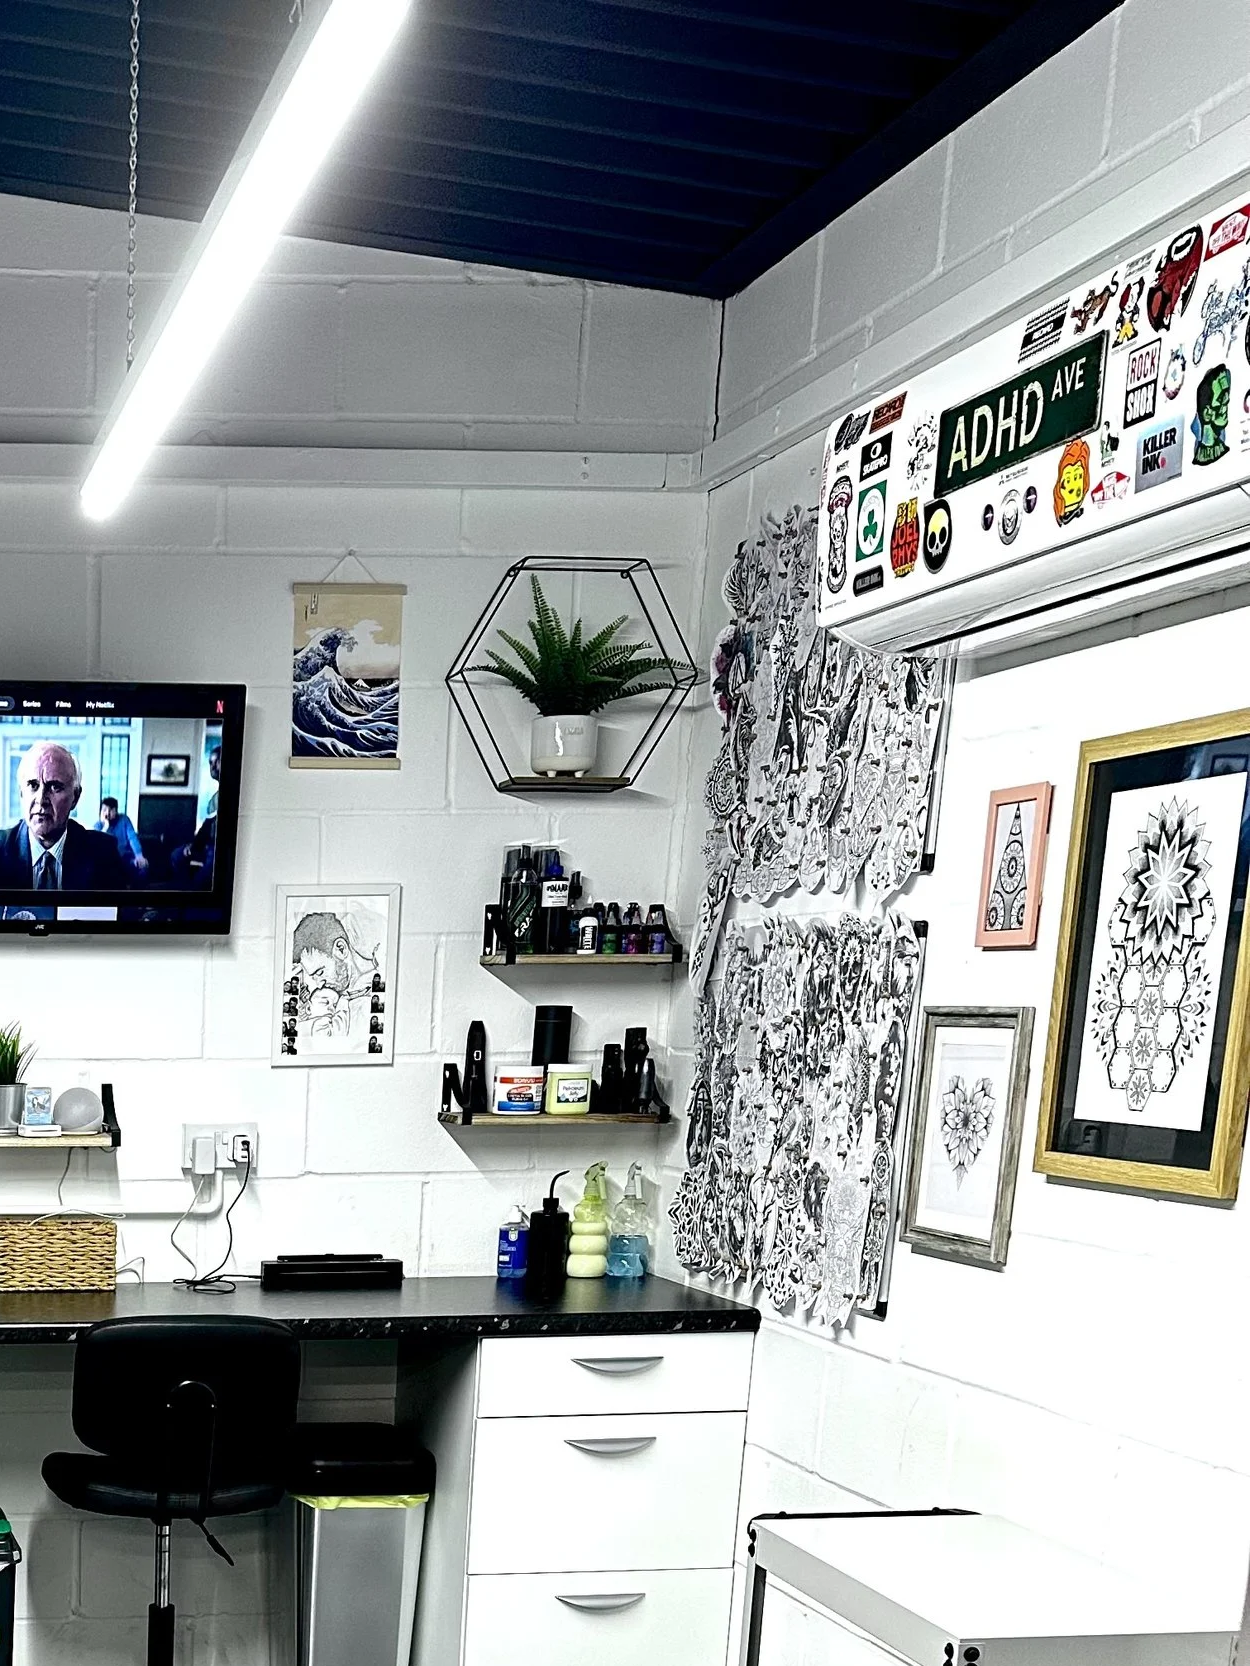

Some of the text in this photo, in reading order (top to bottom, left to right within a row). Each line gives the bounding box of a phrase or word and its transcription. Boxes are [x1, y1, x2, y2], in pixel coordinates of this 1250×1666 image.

[1130, 347, 1157, 384] ROCK
[947, 356, 1087, 478] ADHD AVE
[1143, 427, 1177, 457] KILLER
[893, 519, 918, 548] JOEL
[892, 541, 918, 567] RHYS
[583, 926, 593, 950] WHITE
